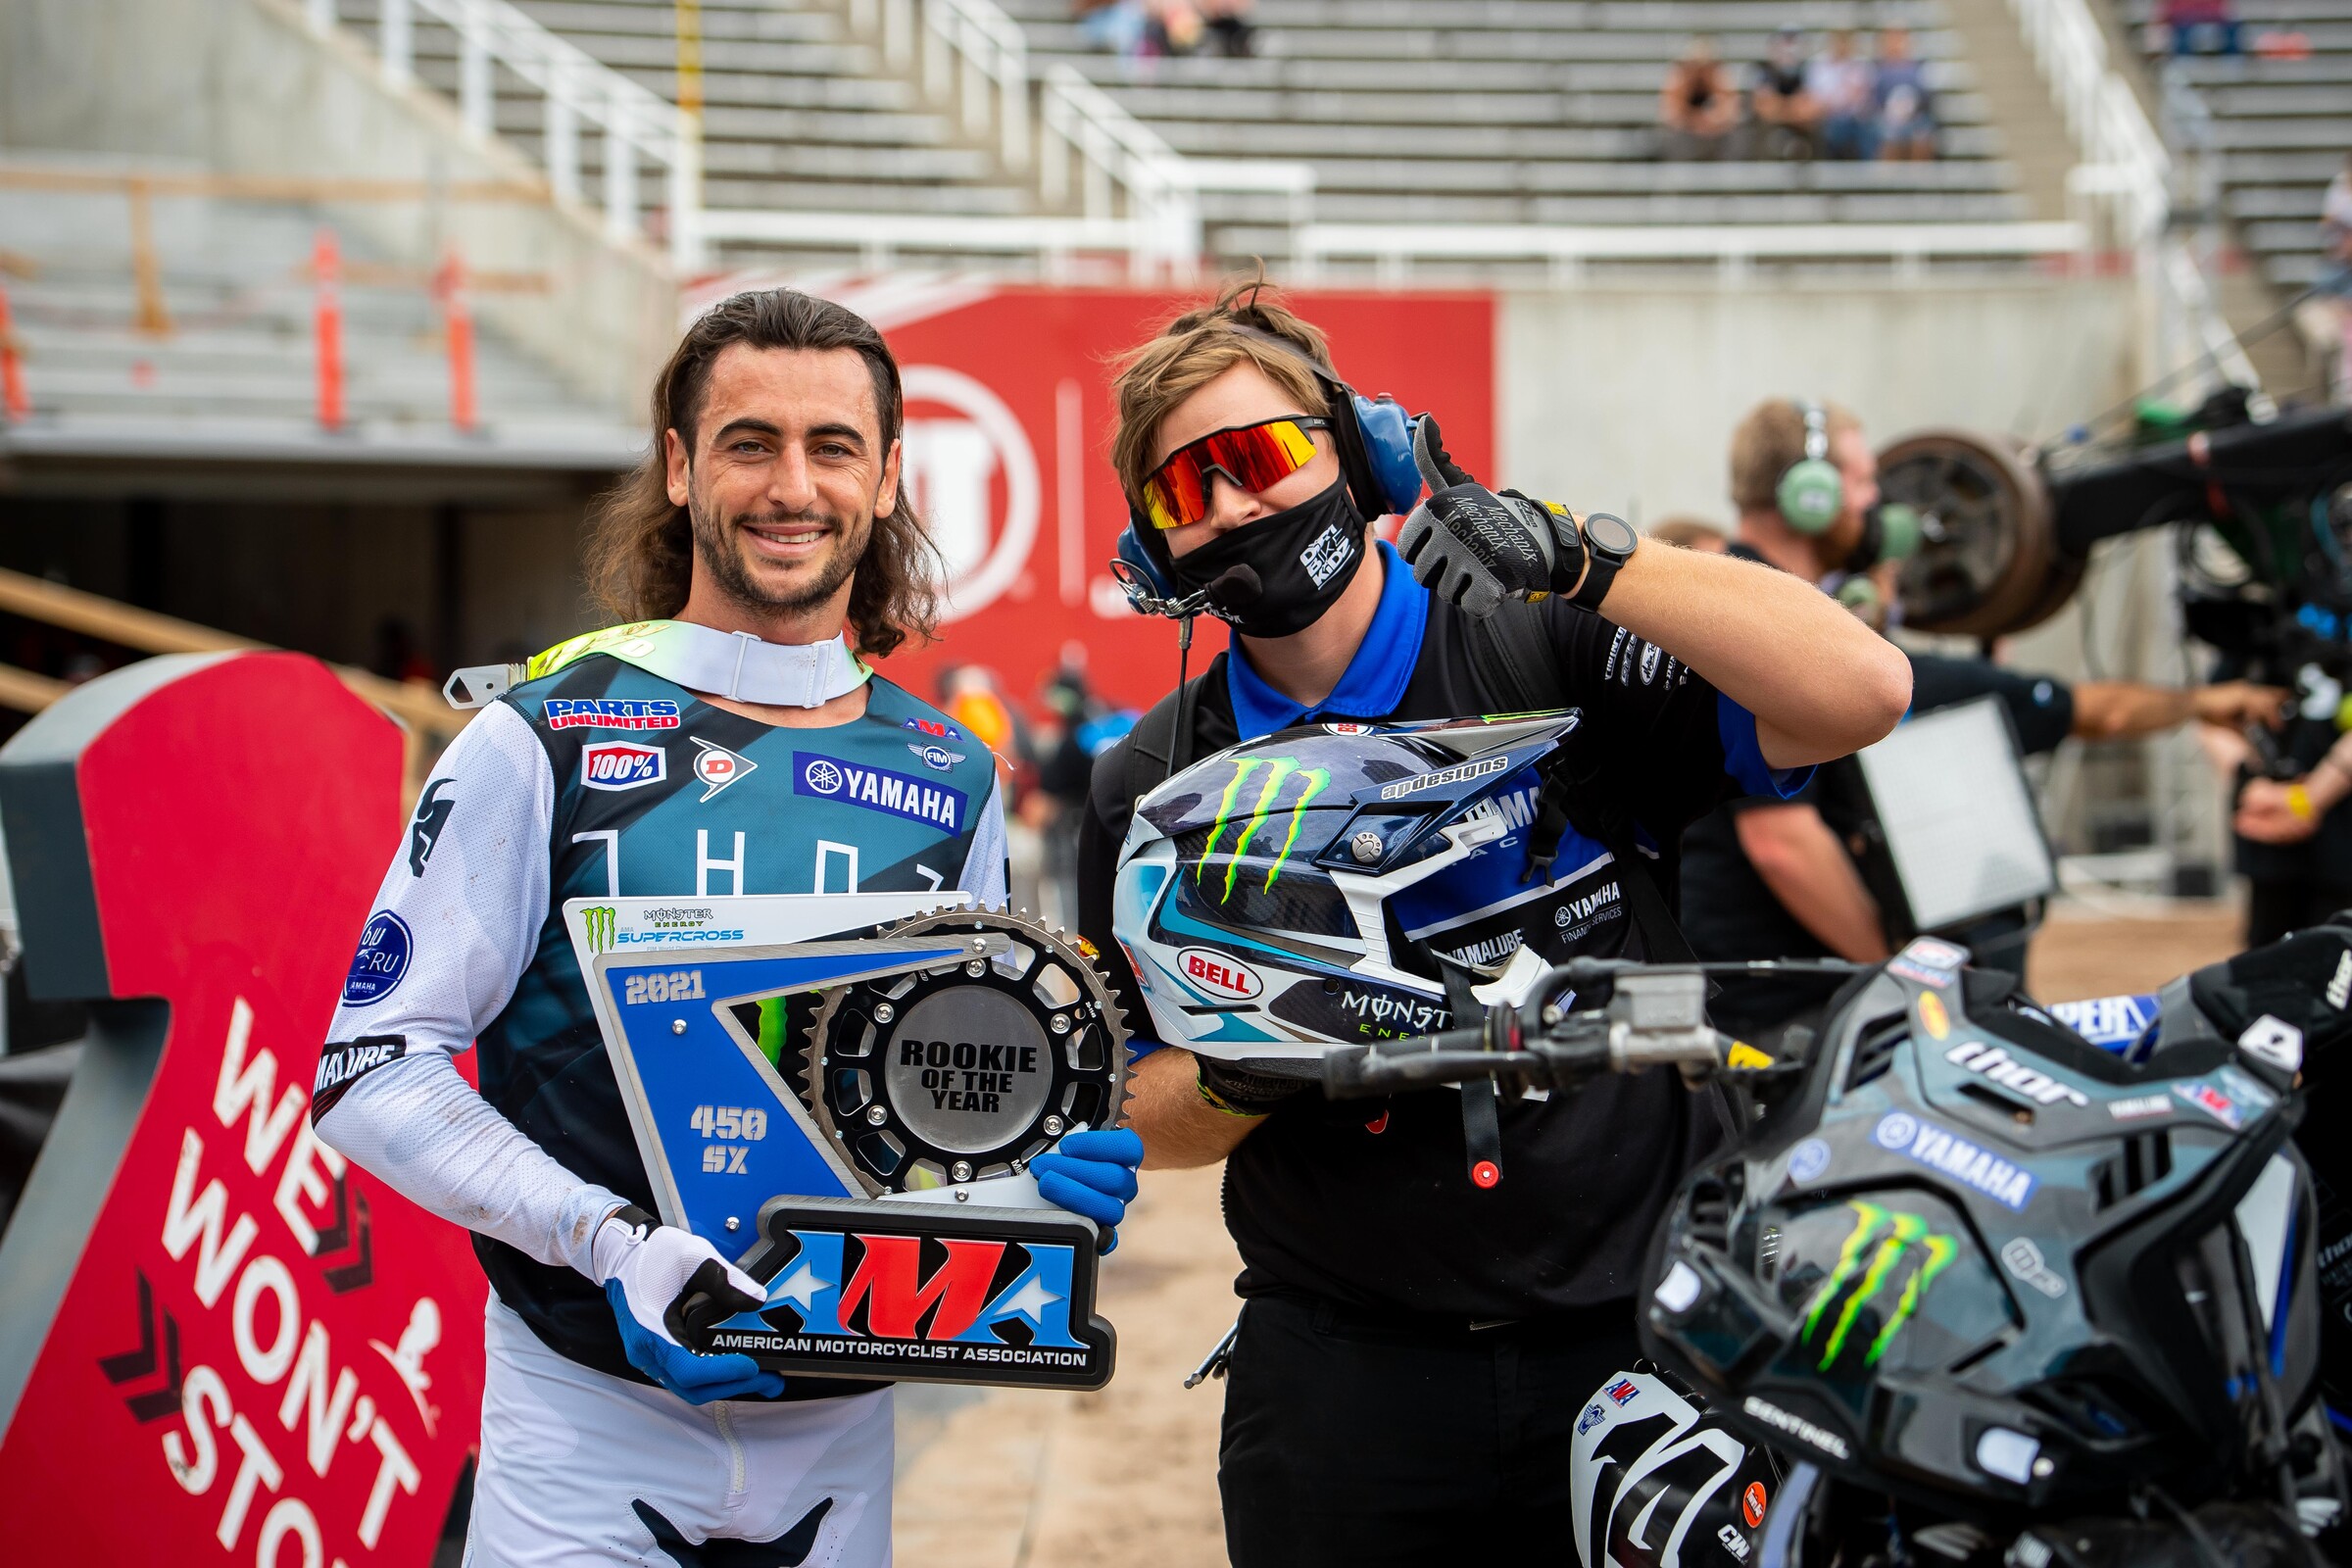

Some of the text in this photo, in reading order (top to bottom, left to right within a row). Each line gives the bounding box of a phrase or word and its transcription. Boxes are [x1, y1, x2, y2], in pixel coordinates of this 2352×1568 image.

[1452, 497, 1510, 551] Mechanix
[1485, 506, 1538, 564] Mechanix
[545, 700, 678, 717] PARTS
[550, 715, 680, 730] UNLIMITED
[901, 716, 965, 743] AMA
[590, 752, 653, 780] 100%
[707, 760, 732, 775] D
[927, 753, 948, 763] FIM
[1382, 757, 1508, 800] apdesigns
[845, 769, 956, 828] YAMAHA
[644, 907, 713, 921] MONSTER
[1570, 882, 1620, 920] YAMAHA
[1592, 906, 1622, 925] SERVICES
[617, 930, 744, 943] SUPERCROSS
[1447, 929, 1523, 964] YAMALUBE
[350, 981, 375, 991] AMAHA
[625, 970, 706, 1005] 2021
[1187, 955, 1253, 996] BELL
[1342, 991, 1452, 1029] MONST
[901, 1040, 1037, 1073] ROOKIE
[1945, 1042, 2088, 1106] thor
[921, 1068, 1012, 1093] OF THE
[931, 1090, 1000, 1112] YEAR
[213, 995, 348, 1256] WE
[691, 1104, 766, 1141] 450
[703, 1146, 749, 1174] SX
[1911, 1124, 2032, 1207] YAMAHA
[708, 1230, 1090, 1348] AMA
[162, 1127, 421, 1551] WON'T
[712, 1334, 1087, 1367] AMERICAN MOTORCYCLIST ASSOCIATION
[1743, 1396, 1850, 1460] SENTINEL
[163, 1365, 349, 1568] STO
[1718, 1524, 1750, 1558] CW
